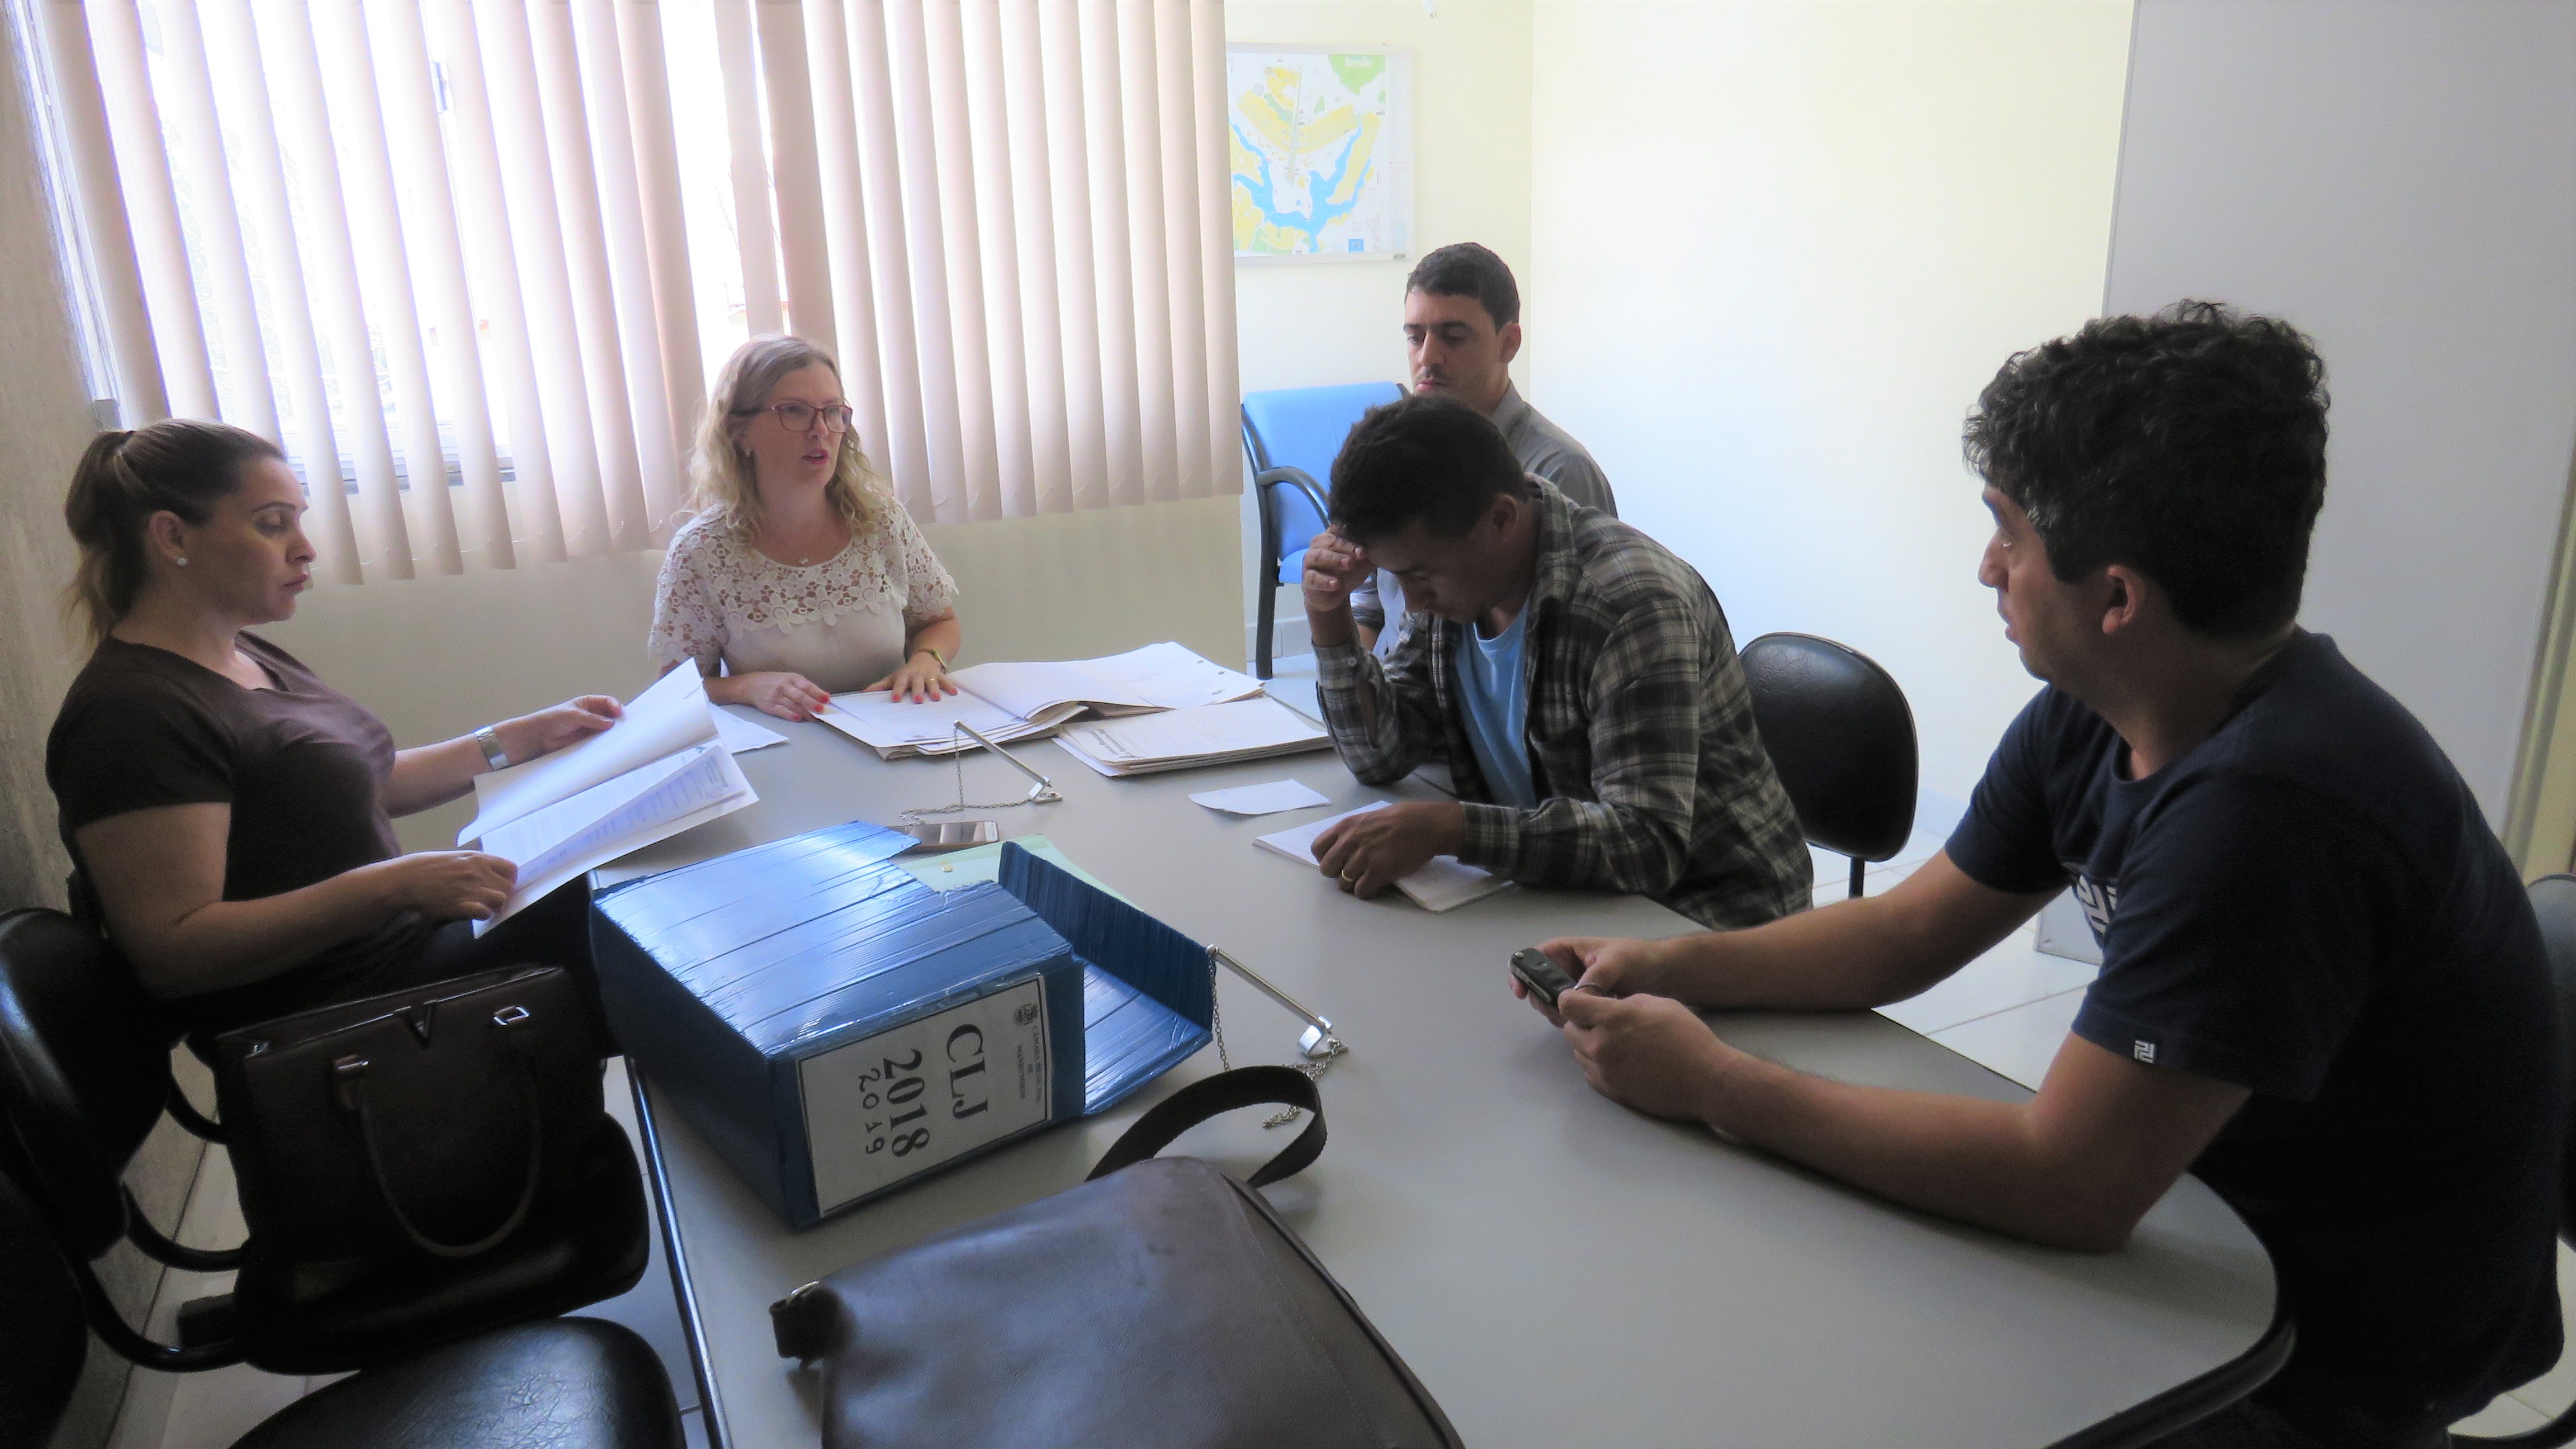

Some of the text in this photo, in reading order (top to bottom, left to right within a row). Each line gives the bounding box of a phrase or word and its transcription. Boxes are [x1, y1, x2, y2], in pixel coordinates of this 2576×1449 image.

[859, 1068, 884, 1154] 2019
[883, 1049, 930, 1157] 2018
[947, 1024, 988, 1120] CLJ
